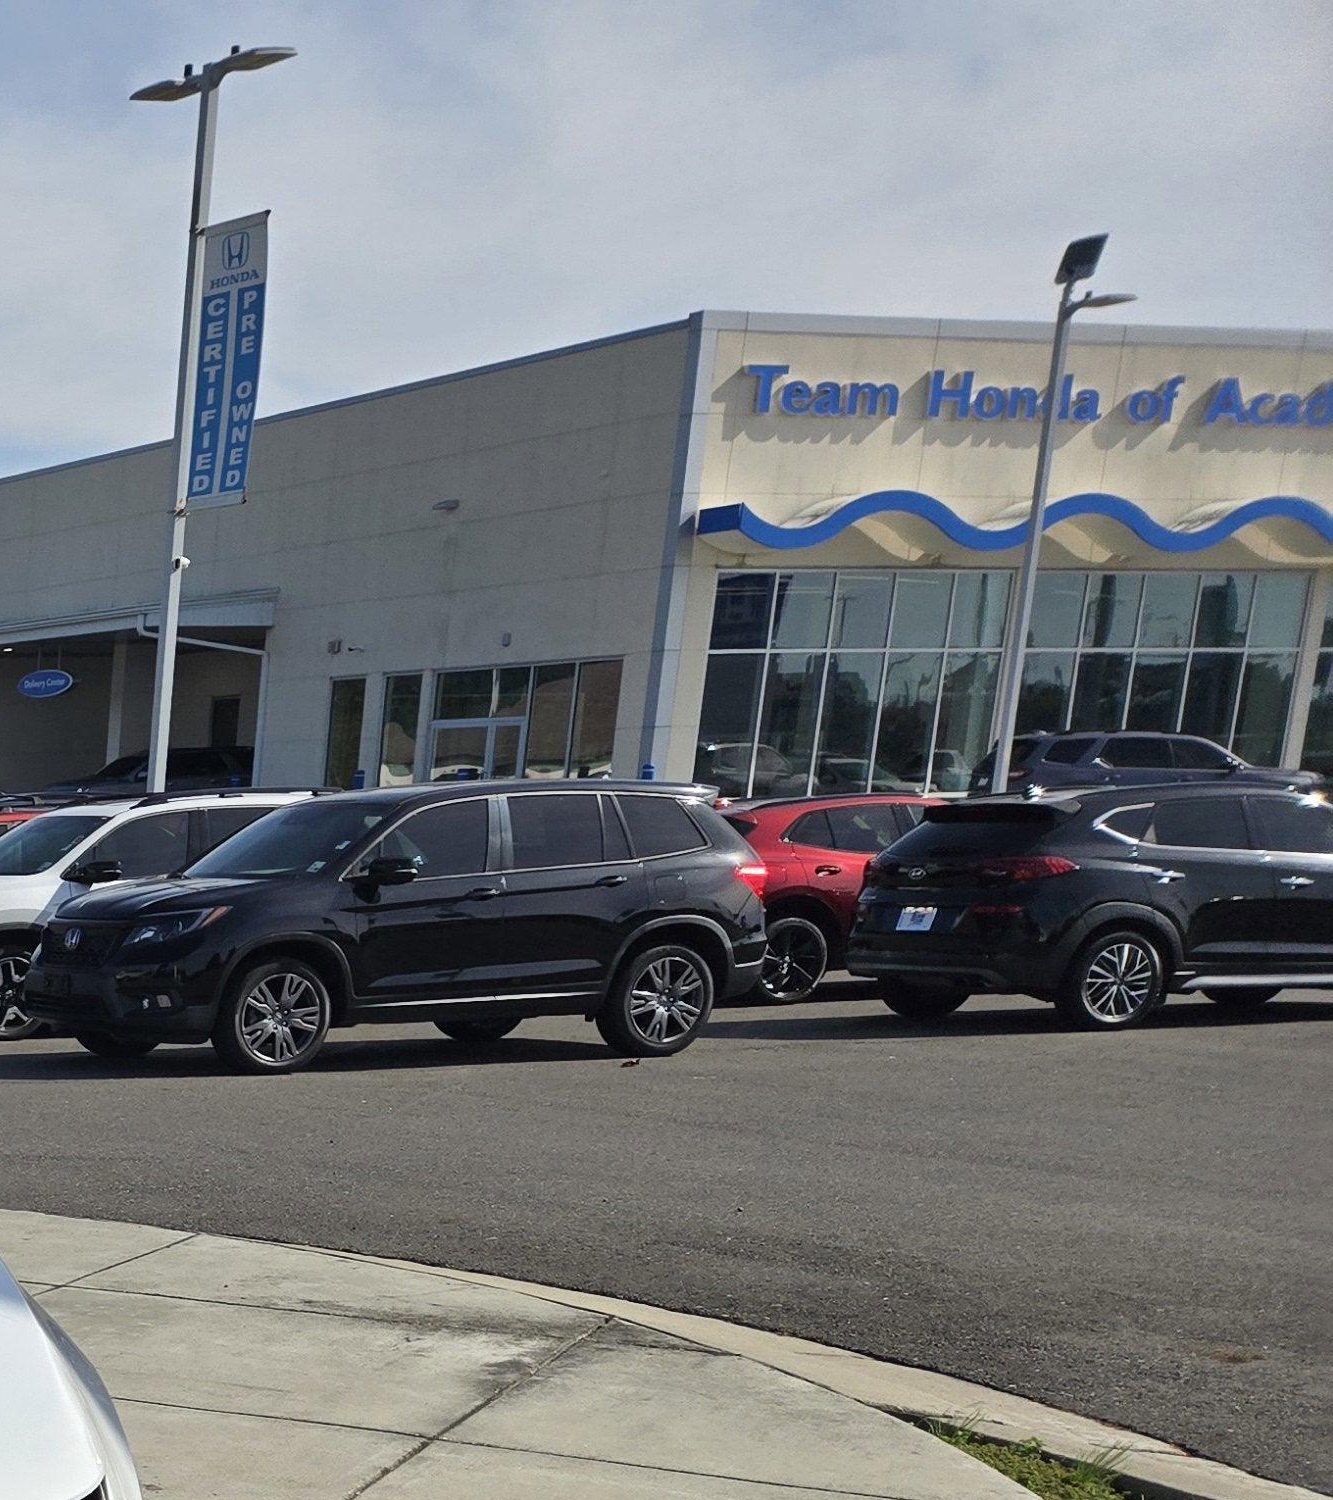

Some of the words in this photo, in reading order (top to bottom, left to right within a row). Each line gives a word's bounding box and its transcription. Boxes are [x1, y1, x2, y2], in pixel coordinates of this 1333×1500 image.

[210, 269, 260, 290] HONDA
[240, 290, 259, 355] PRE
[192, 297, 226, 493] CERTIFIED
[745, 364, 900, 417] Team
[927, 369, 1102, 422] Honda
[1126, 375, 1187, 424] of
[224, 380, 253, 489] OWNED
